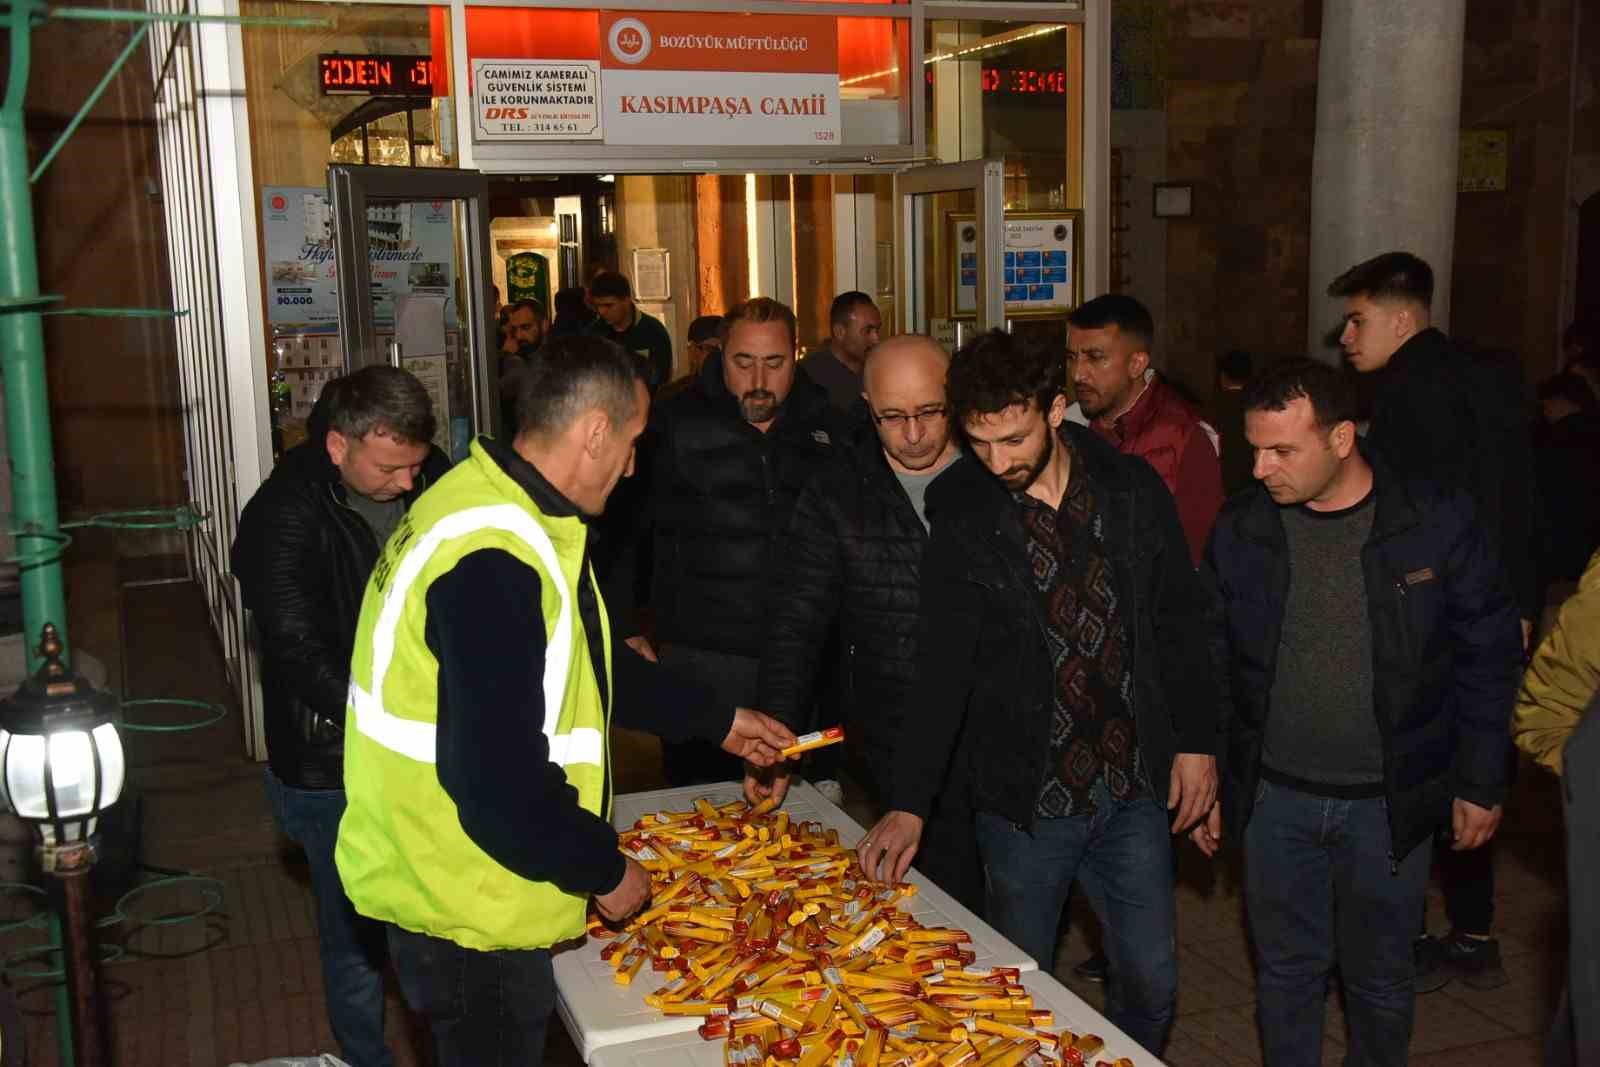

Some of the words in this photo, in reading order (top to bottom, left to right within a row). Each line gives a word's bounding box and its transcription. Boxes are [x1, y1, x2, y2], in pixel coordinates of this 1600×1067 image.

[659, 35, 722, 49] BOZÜYÜK
[724, 35, 808, 51] MÜFTÜLÜĞÜ
[535, 70, 588, 79] KAMERALI
[501, 96, 594, 105] KORUNMAKTADIR
[620, 95, 752, 119] KASIMPAŞA
[760, 93, 826, 116] CAMİİ
[485, 108, 529, 120] DRS
